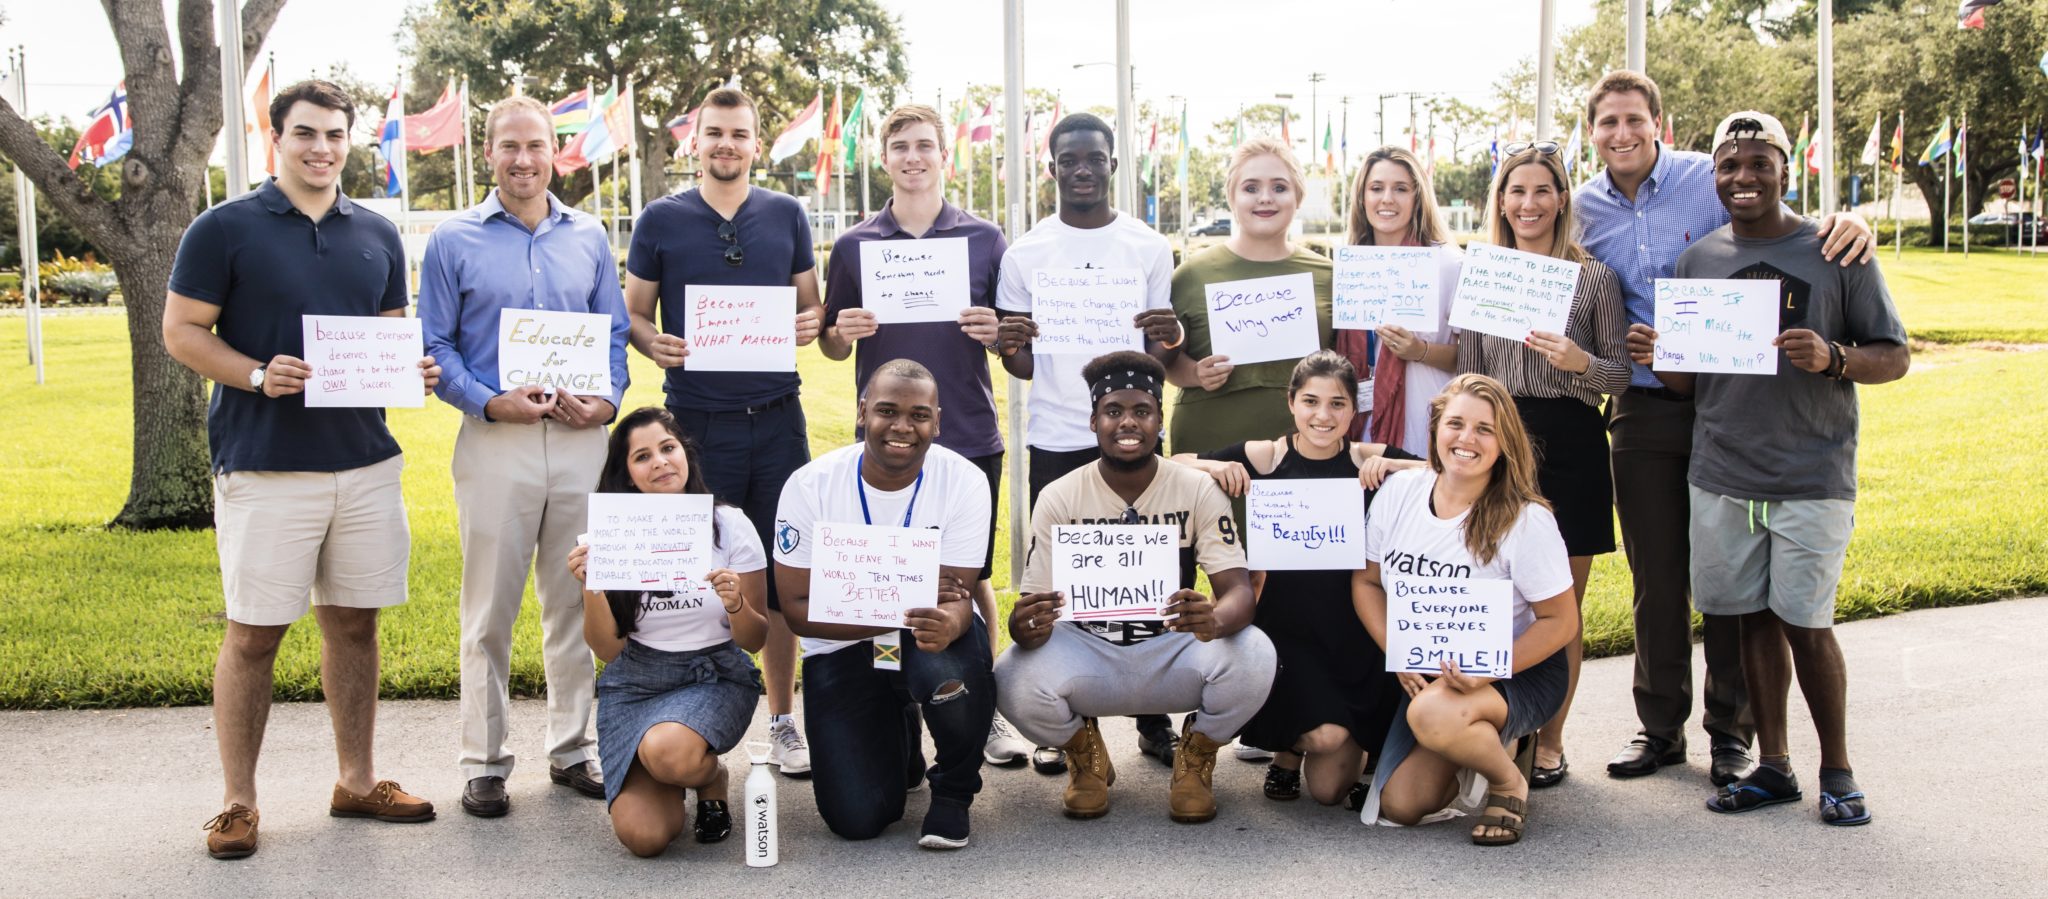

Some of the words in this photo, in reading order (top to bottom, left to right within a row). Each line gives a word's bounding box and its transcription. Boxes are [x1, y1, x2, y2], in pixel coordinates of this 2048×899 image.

[881, 248, 932, 264] Because
[1339, 247, 1385, 263] Because
[1391, 250, 1432, 267] everyone
[1472, 248, 1481, 257] I
[1489, 252, 1520, 264] WANT
[1525, 261, 1536, 270] TO
[1542, 264, 1573, 280] LEAVE
[1096, 274, 1109, 286] I
[1337, 267, 1381, 279] deserves
[1386, 266, 1400, 276] the
[1470, 266, 1489, 277] THE
[1495, 271, 1523, 283] WORLD
[1541, 279, 1573, 293] BETTER
[1411, 279, 1431, 289] live
[1463, 277, 1490, 288] PLACE
[1494, 282, 1516, 293] THAN
[1526, 288, 1552, 301] FOUND
[1556, 294, 1567, 305] IT
[1212, 289, 1296, 312] Because
[1336, 293, 1358, 306] their
[1391, 294, 1425, 307] JOY
[1674, 300, 1698, 315] I
[1271, 306, 1303, 322] not?
[1485, 309, 1497, 319] the
[1548, 308, 1557, 318] to
[695, 312, 740, 330] Impact
[315, 320, 366, 341] because
[375, 330, 414, 341] everyone
[509, 318, 595, 347] Educate
[1736, 330, 1753, 341] the
[693, 334, 734, 348] WHAT
[1076, 333, 1093, 346] the
[1099, 334, 1131, 345] world
[328, 348, 368, 361] deserves
[379, 350, 397, 360] the
[542, 351, 568, 367] for
[1655, 345, 1685, 365] Change
[317, 365, 346, 377] chance
[356, 365, 365, 374] to
[371, 365, 380, 373] be
[385, 365, 406, 374] their
[322, 379, 347, 391] OWN
[506, 369, 603, 391] CHANGE
[1252, 498, 1258, 507] I
[1299, 499, 1310, 509] to
[608, 514, 619, 523] TO
[627, 513, 654, 523] MAKE
[662, 514, 668, 523] A
[675, 513, 709, 522] POSITIVE
[1250, 520, 1264, 530] the
[593, 528, 620, 538] IMPACT
[624, 528, 636, 537] ON
[642, 528, 658, 537] THE
[664, 527, 696, 536] WORLD
[1057, 526, 1135, 546] because
[1144, 531, 1169, 546] we
[1218, 515, 1236, 545] 9
[594, 543, 627, 551] THROUGH
[634, 543, 646, 551] AN
[650, 542, 693, 551] INNOVATIVE
[888, 535, 900, 548] I
[912, 539, 938, 550] WANT
[593, 556, 615, 566] FORM
[618, 558, 629, 567] OF
[632, 558, 673, 567] EDUCATION
[677, 556, 699, 565] THAT
[836, 551, 848, 562] TO
[855, 554, 883, 564] LEAVE
[1071, 552, 1106, 569] are
[1118, 550, 1143, 567] all
[595, 571, 632, 580] ENABLES
[639, 571, 667, 580] YOUTH
[674, 571, 687, 579] TO
[822, 569, 856, 580] WORLD
[868, 571, 890, 583] TEN
[841, 582, 900, 603] BETTER
[1071, 579, 1164, 611] HUMAN!!
[1395, 580, 1470, 597] BECAUSE
[641, 598, 703, 612] WOMAN
[1411, 601, 1489, 618] EVERYONE
[825, 606, 844, 618] than
[854, 609, 864, 619] I
[871, 609, 897, 621] found
[1398, 620, 1486, 632] DESERVES
[1431, 635, 1449, 645] TO
[1407, 646, 1508, 667] SMILE!!
[758, 809, 769, 858] watson
